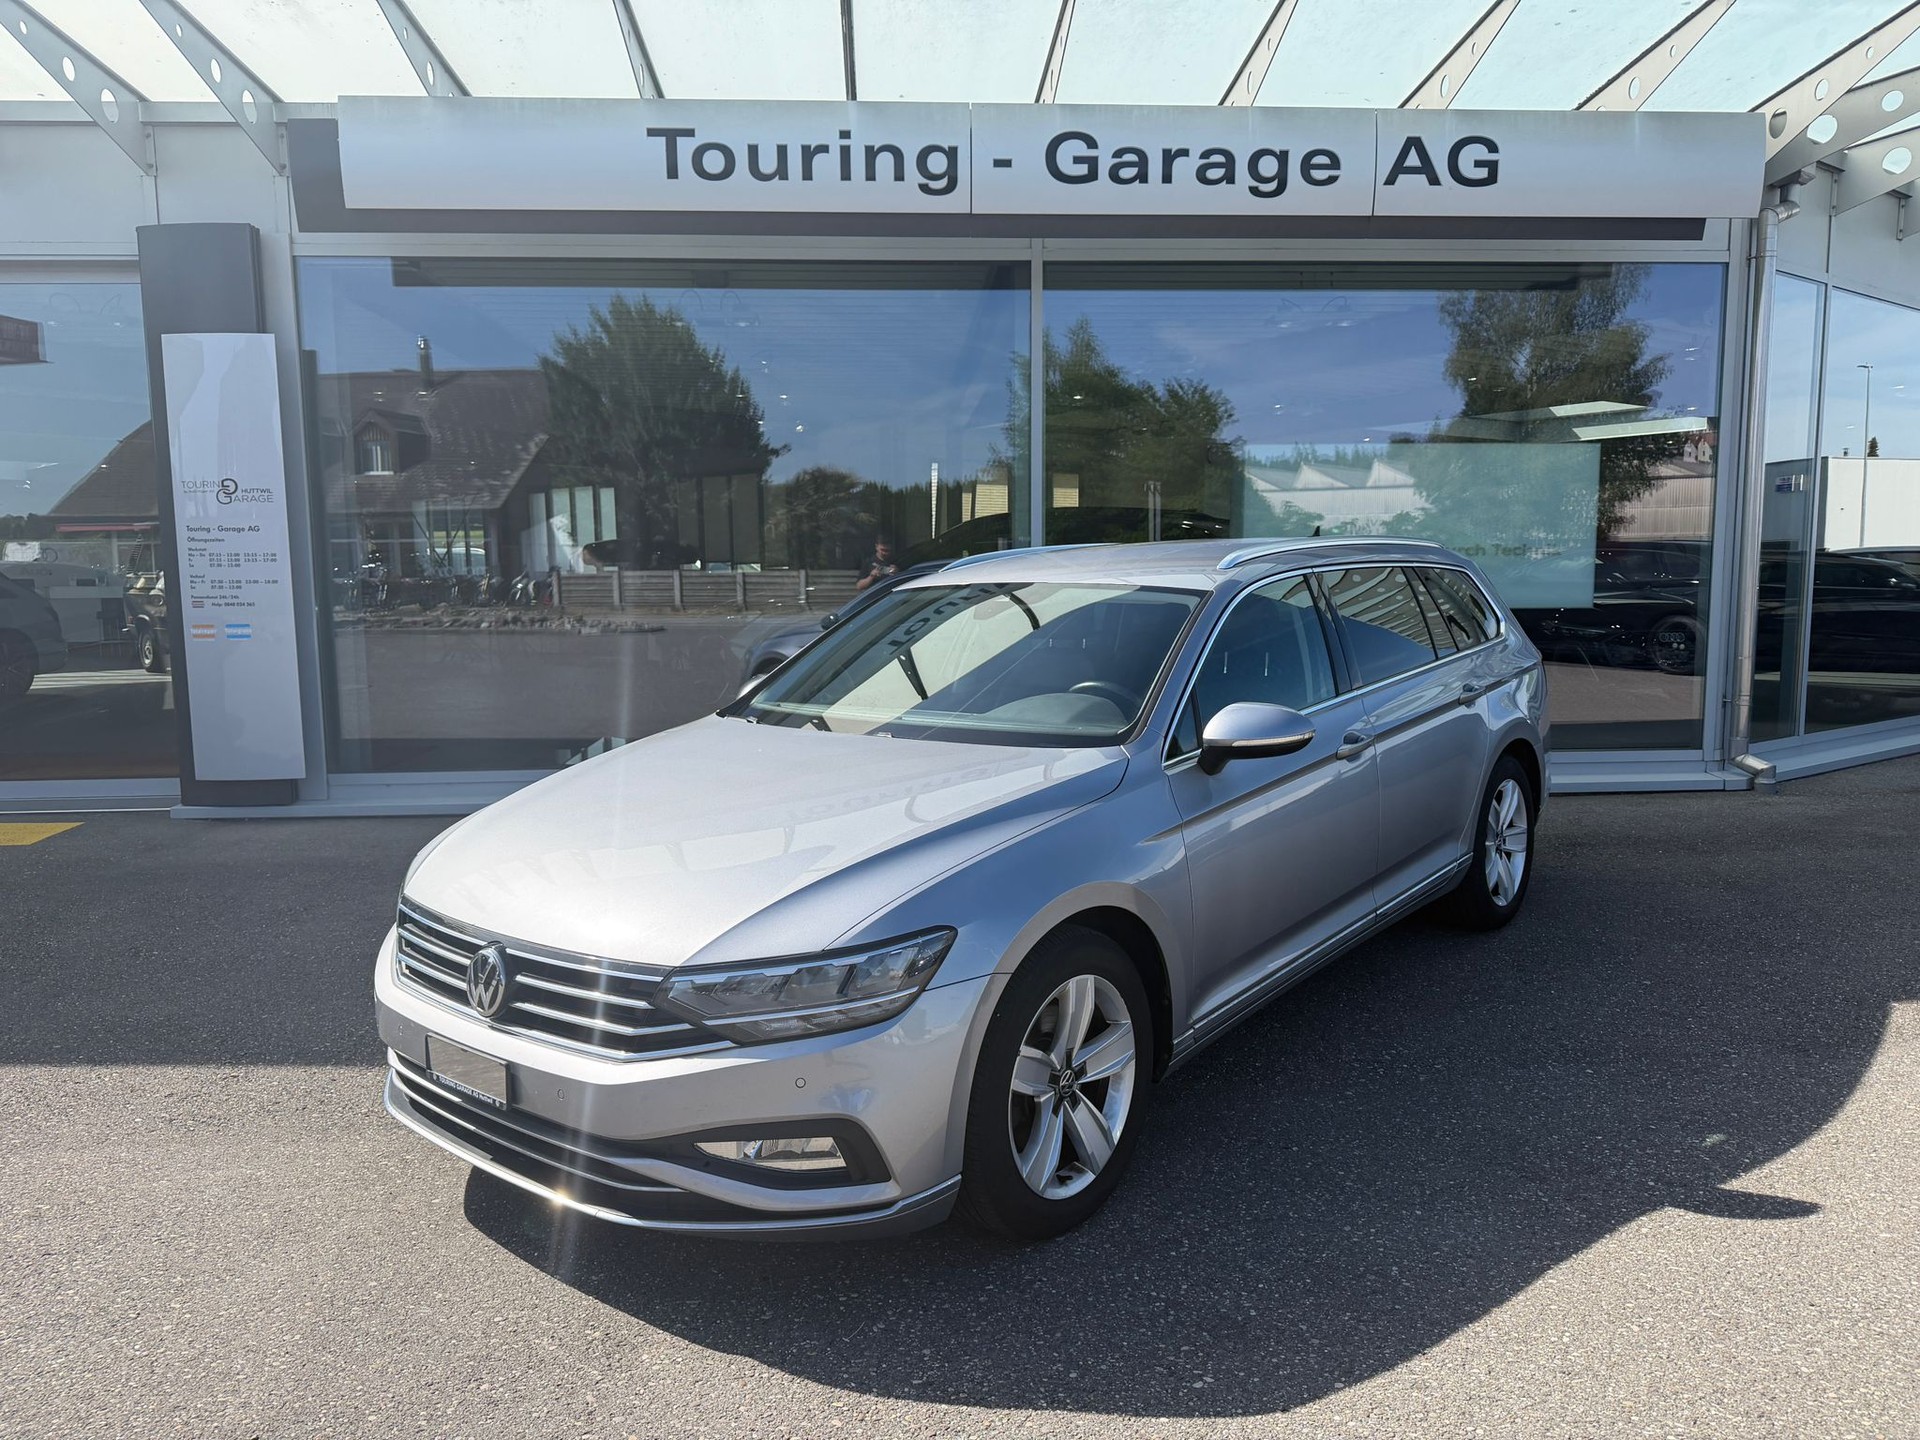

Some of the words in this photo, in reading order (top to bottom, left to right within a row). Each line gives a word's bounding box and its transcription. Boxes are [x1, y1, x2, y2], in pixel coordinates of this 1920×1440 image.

[647, 128, 958, 196] Touring
[993, 158, 1012, 168] -
[1045, 131, 1341, 198] Garage
[1383, 135, 1499, 187] AG
[186, 525, 210, 533] Touring
[218, 525, 245, 533] Garage
